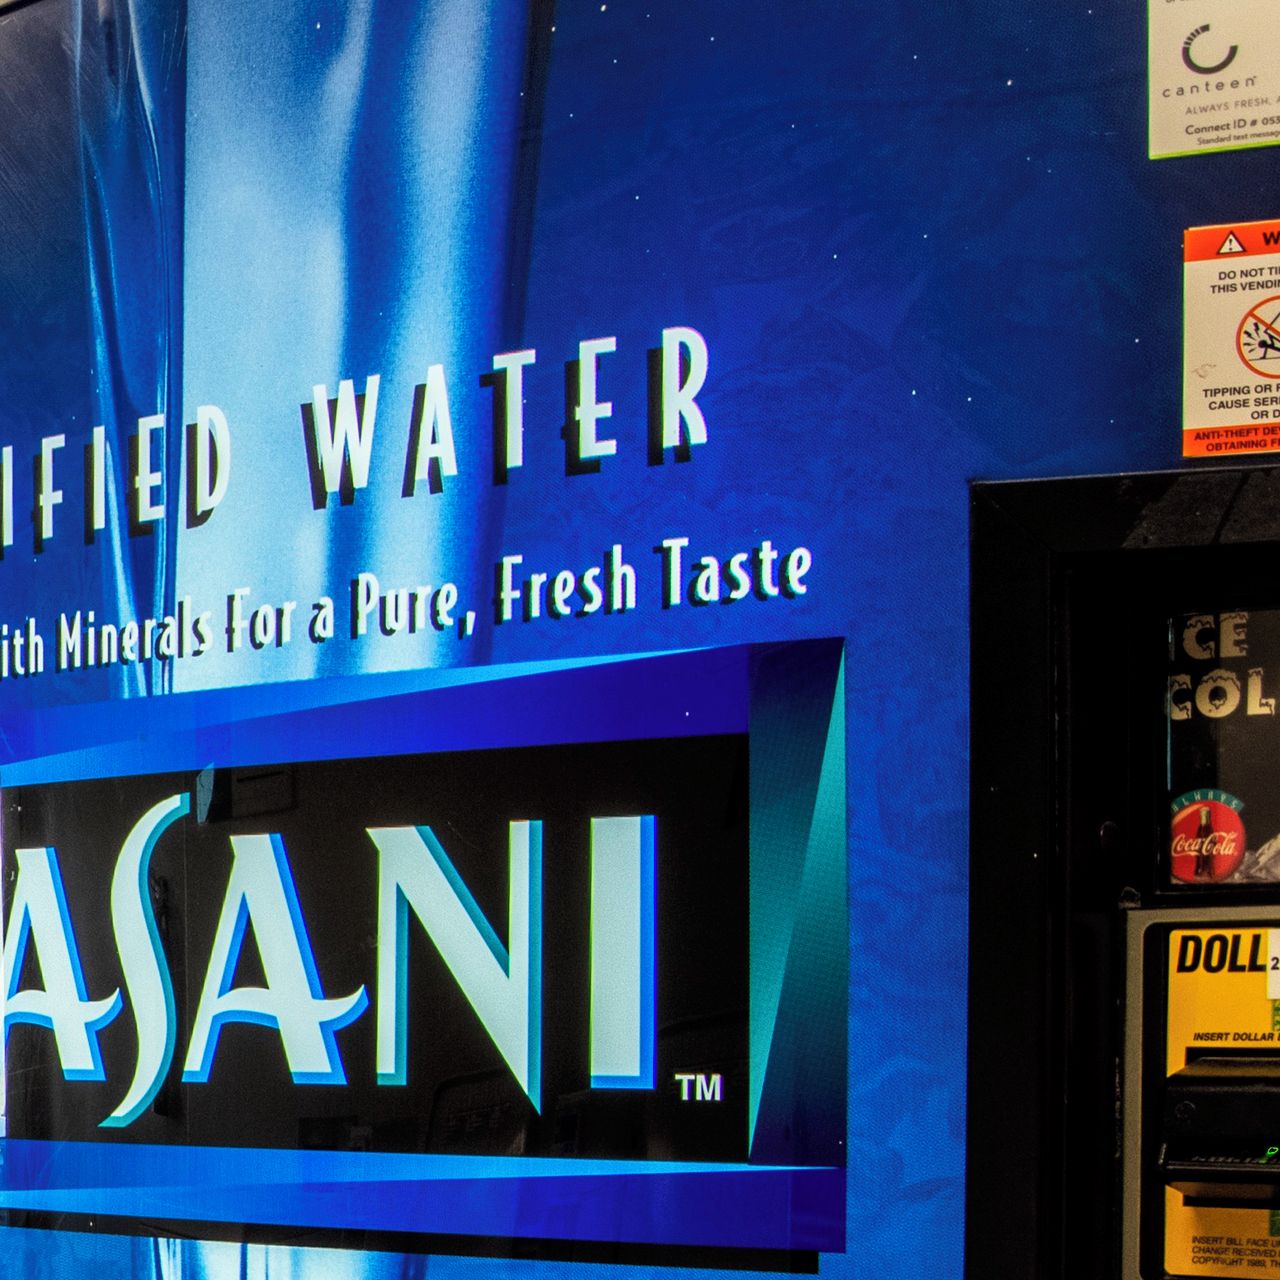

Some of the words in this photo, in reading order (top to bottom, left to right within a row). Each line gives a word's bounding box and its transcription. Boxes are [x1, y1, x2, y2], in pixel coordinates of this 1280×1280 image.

[1161, 77, 1255, 97] canteen
[1185, 102, 1229, 115] ALWAYS
[1185, 123, 1230, 135] Connect
[1234, 119, 1247, 129] ID
[1218, 271, 1237, 281] DO
[1240, 268, 1265, 279] NOT
[1268, 266, 1280, 276] TI
[1210, 283, 1238, 294] THIS
[1202, 386, 1251, 398] TIPPING
[1254, 384, 1273, 394] OR
[1208, 399, 1250, 410] CAUSE
[306, 326, 709, 503] WATER
[1251, 410, 1269, 420] OR
[1194, 428, 1260, 441] ANTI-THEFT
[1206, 439, 1267, 452] OBTAINING
[57, 595, 214, 671] Minerals
[227, 586, 298, 652] For
[308, 591, 336, 641] a
[353, 571, 477, 637] Pure,
[499, 544, 637, 625] Fresh
[661, 535, 813, 608] Taste
[1176, 933, 1267, 973] DOLL
[1193, 1032, 1230, 1041] INSERT
[1233, 1032, 1274, 1041] DOLLAR
[675, 1073, 722, 1101] TM
[1192, 1236, 1223, 1245] INSERT
[1192, 1246, 1230, 1255] CHANGE
